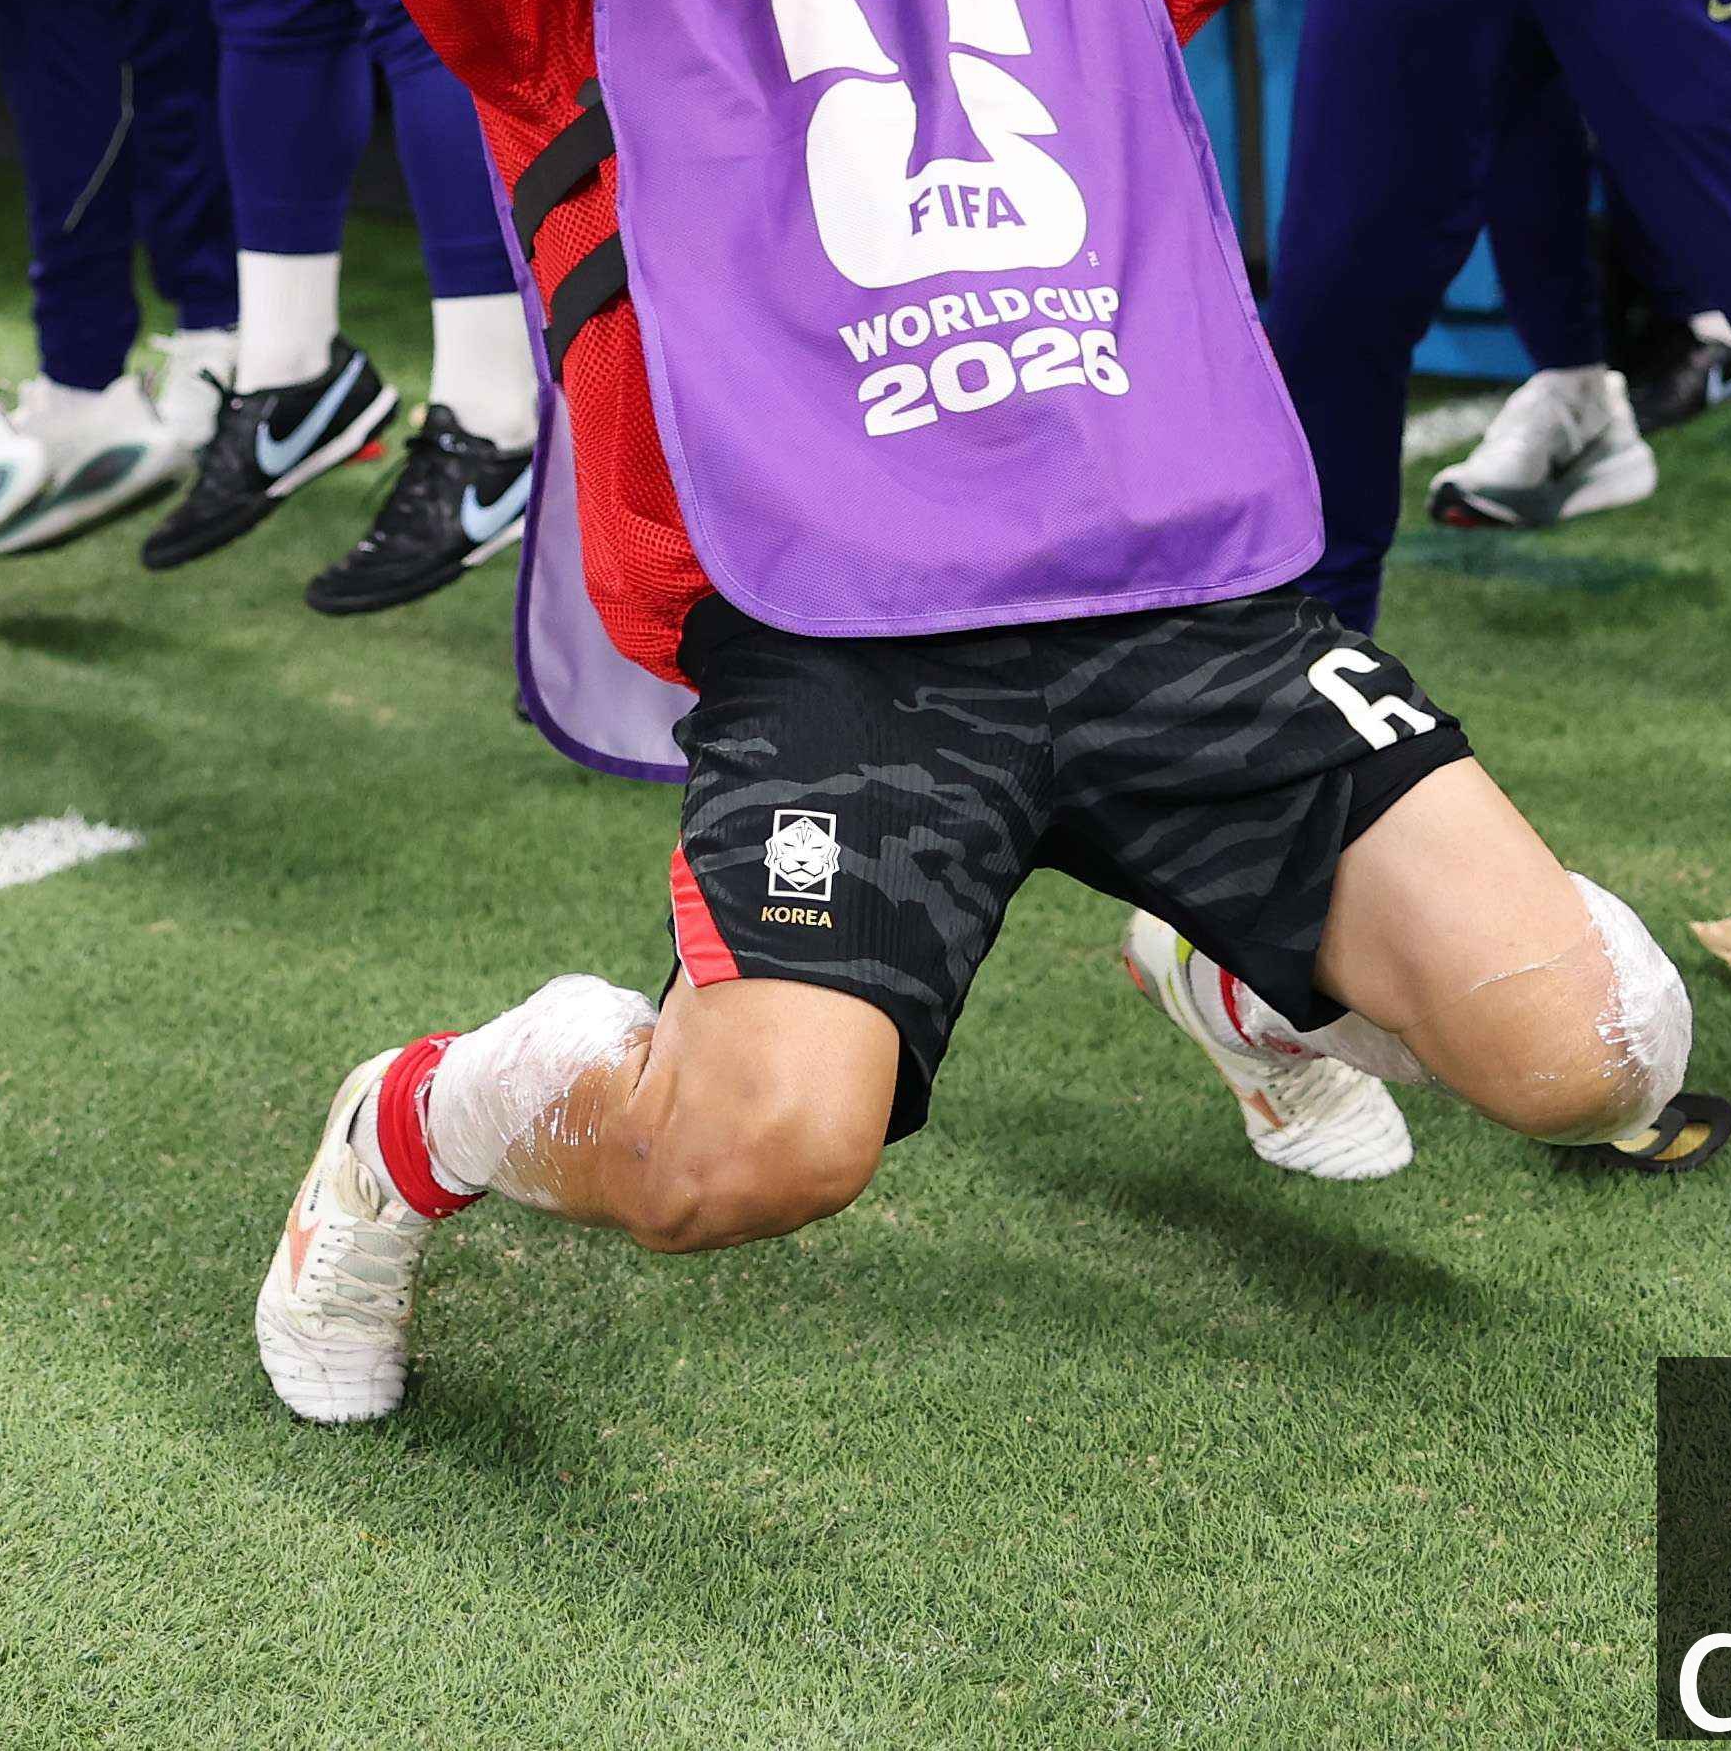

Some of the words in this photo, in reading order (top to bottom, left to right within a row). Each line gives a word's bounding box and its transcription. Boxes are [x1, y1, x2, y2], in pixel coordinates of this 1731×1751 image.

[909, 185, 1027, 236] FIFA
[838, 288, 1031, 363] WORLD
[1033, 286, 1120, 322] CUP
[858, 326, 1131, 437] 2026
[761, 906, 832, 929] KOREA
